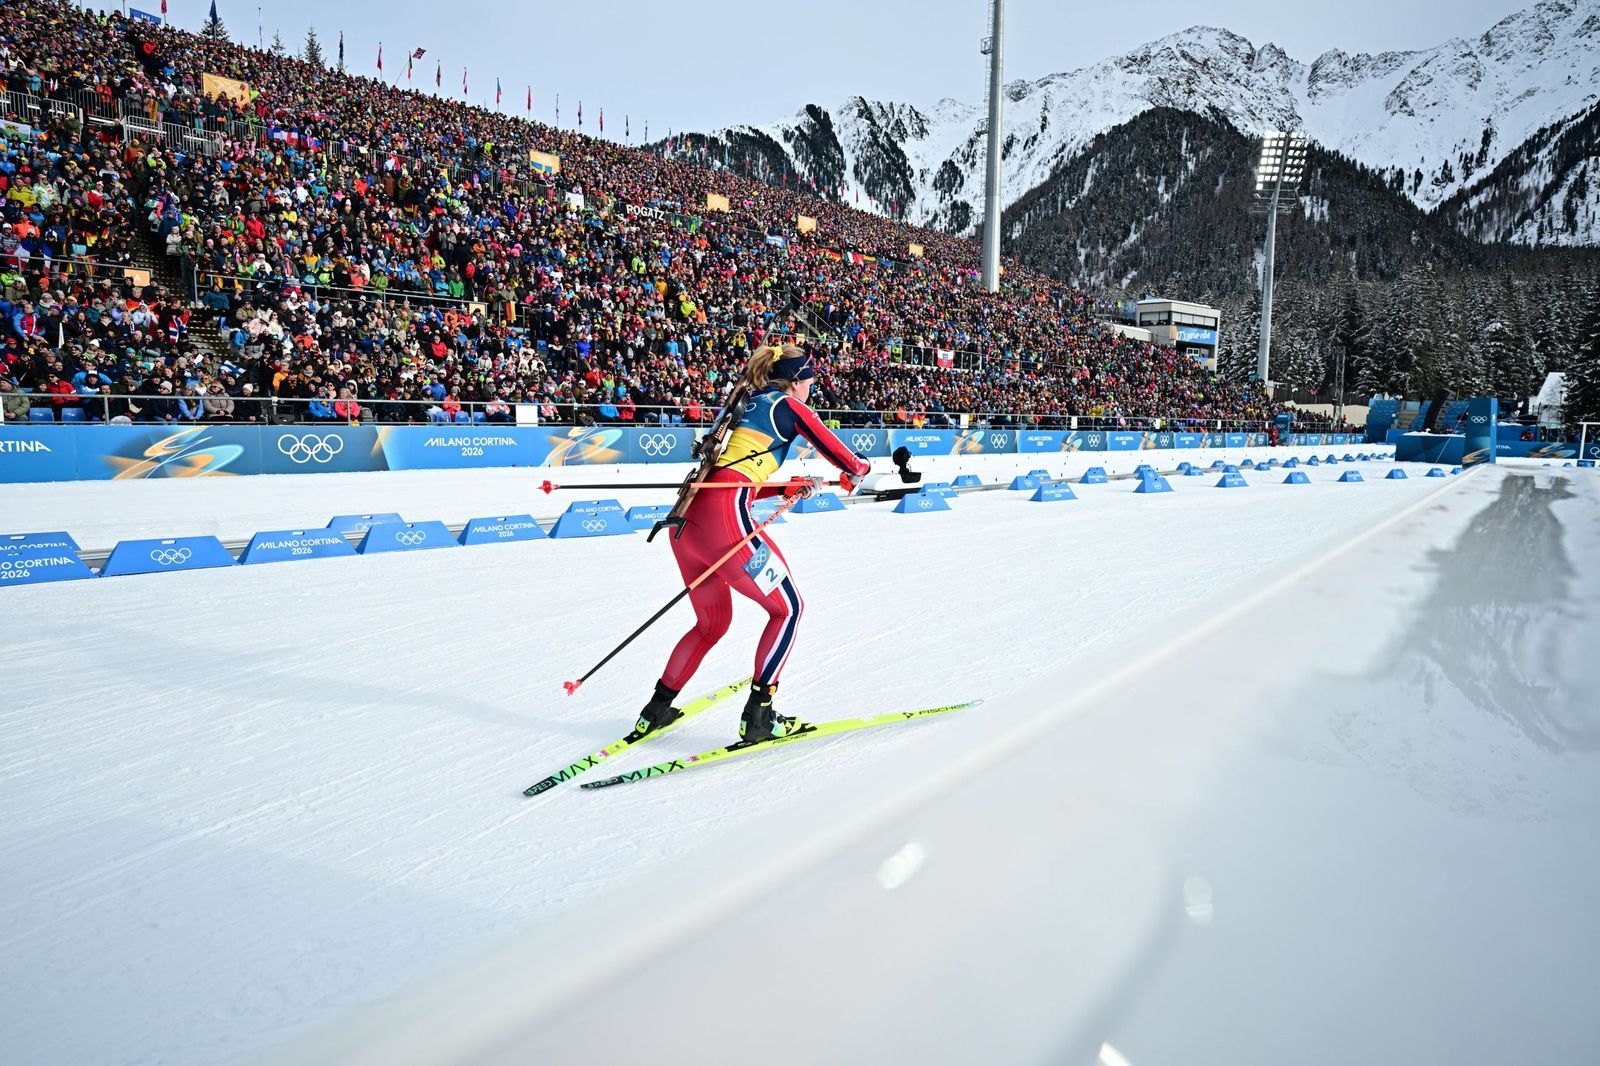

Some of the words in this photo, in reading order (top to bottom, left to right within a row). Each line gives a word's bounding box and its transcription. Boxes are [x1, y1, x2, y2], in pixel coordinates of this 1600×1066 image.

[0, 440, 52, 453] RTINA
[423, 437, 471, 447] MILANO
[472, 437, 518, 446] CORTINA
[461, 447, 484, 456] 2026
[756, 458, 763, 467] 3
[471, 525, 504, 534] MILANO
[504, 522, 537, 531] CORTINA
[498, 530, 514, 538] 2026
[256, 539, 300, 550] MILANO
[300, 537, 344, 547] CORTINA
[291, 547, 312, 555] 2026
[15, 556, 76, 569] CORTINA
[0, 569, 31, 580] 2026
[765, 567, 778, 583] 2
